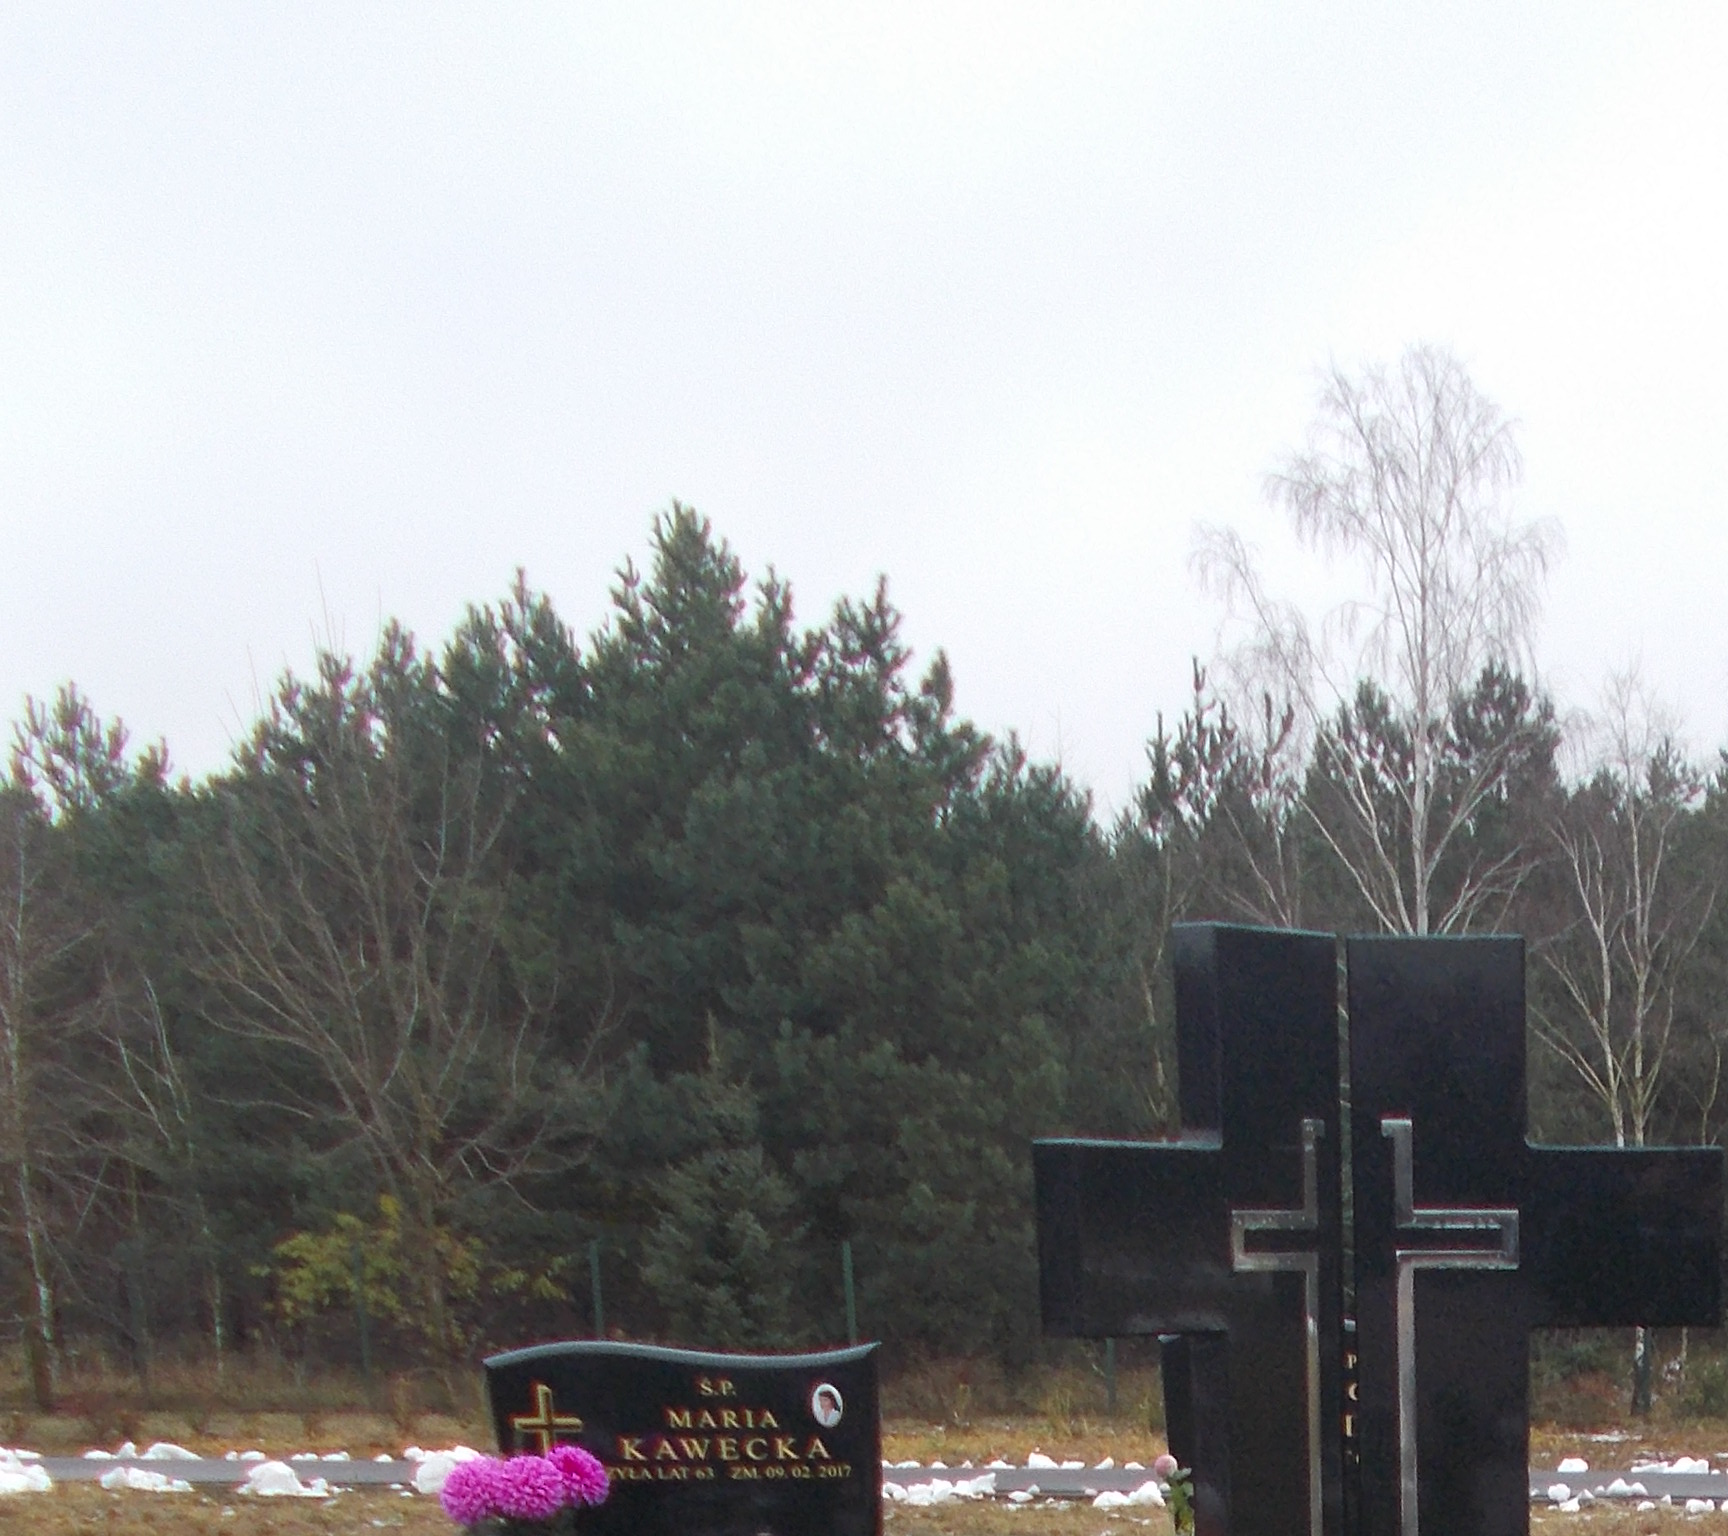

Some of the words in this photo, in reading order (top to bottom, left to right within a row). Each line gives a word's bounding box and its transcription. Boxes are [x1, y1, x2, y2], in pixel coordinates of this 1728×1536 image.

[667, 1408, 780, 1430] MARIA
[621, 1437, 832, 1462] KAWECKA
[657, 1466, 690, 1480] LAT
